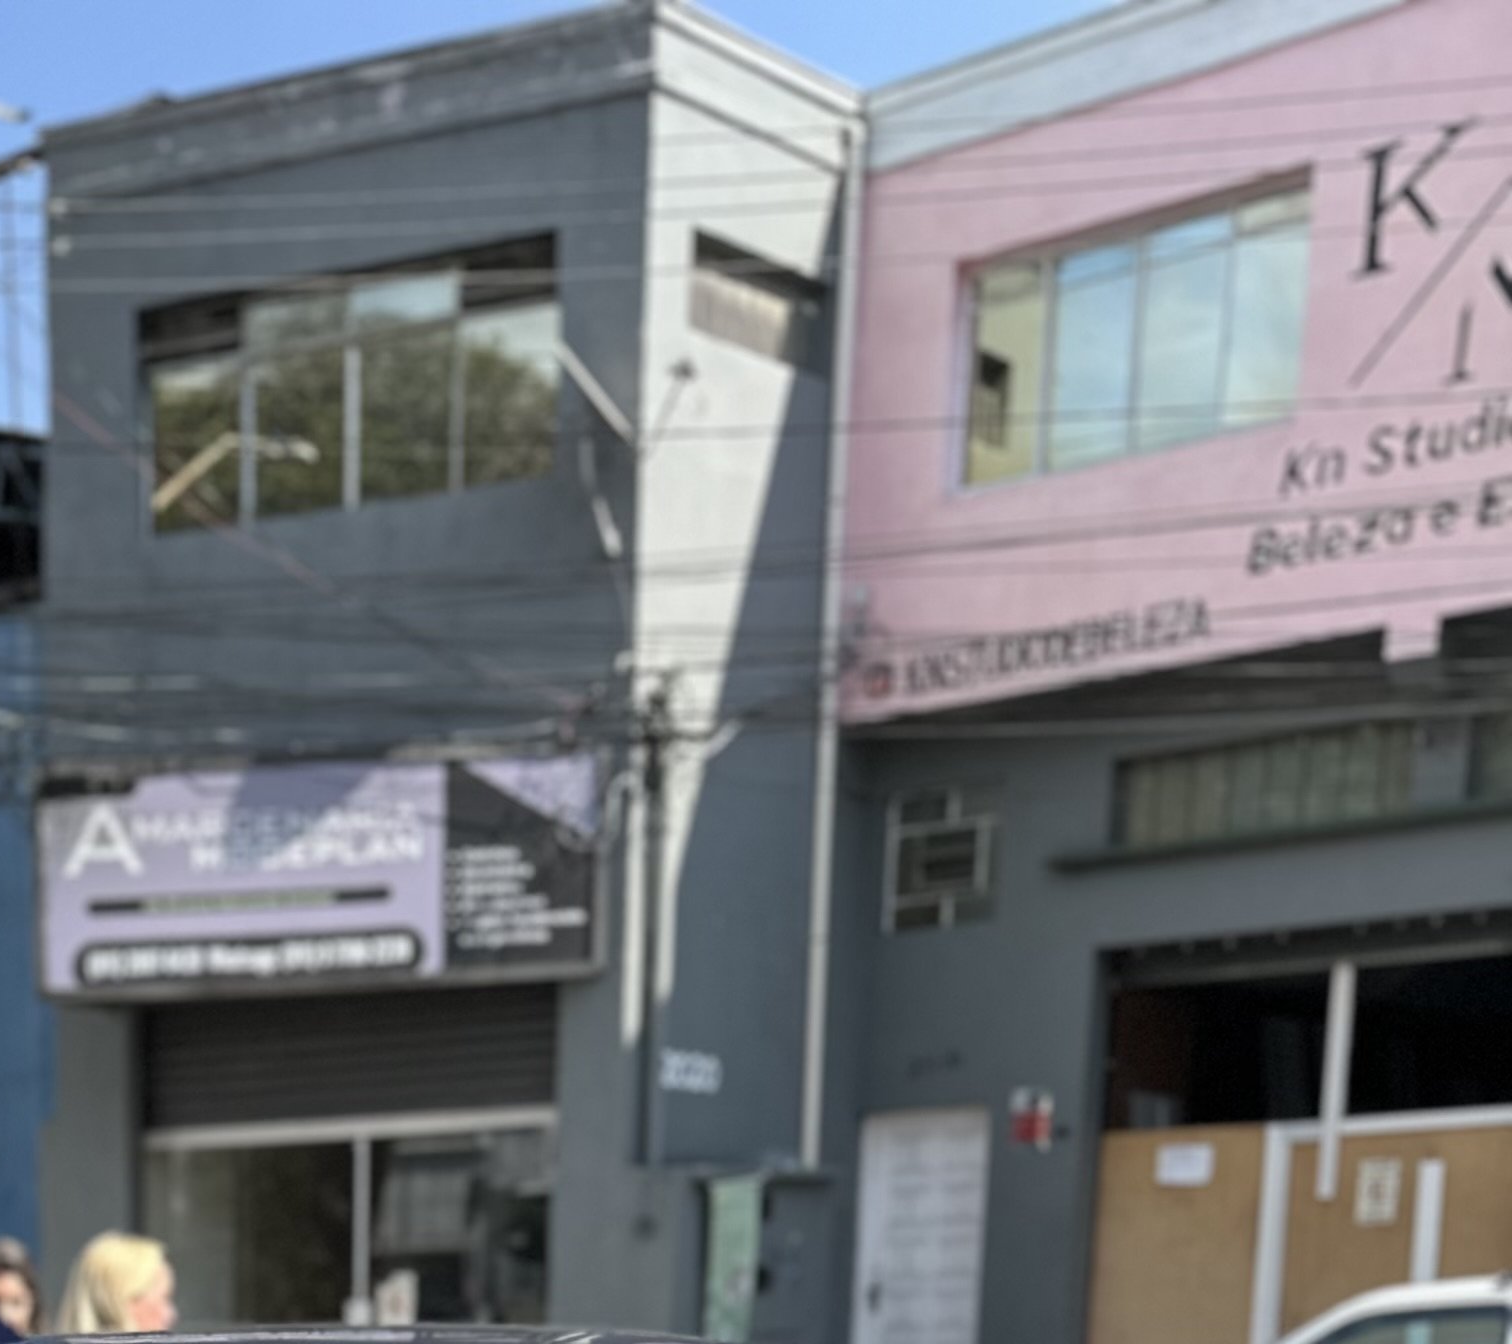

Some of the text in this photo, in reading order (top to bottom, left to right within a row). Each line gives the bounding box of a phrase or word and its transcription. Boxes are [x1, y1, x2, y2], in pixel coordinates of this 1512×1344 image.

[1350, 115, 1480, 282] K
[1277, 392, 1512, 498] Kn Studi
